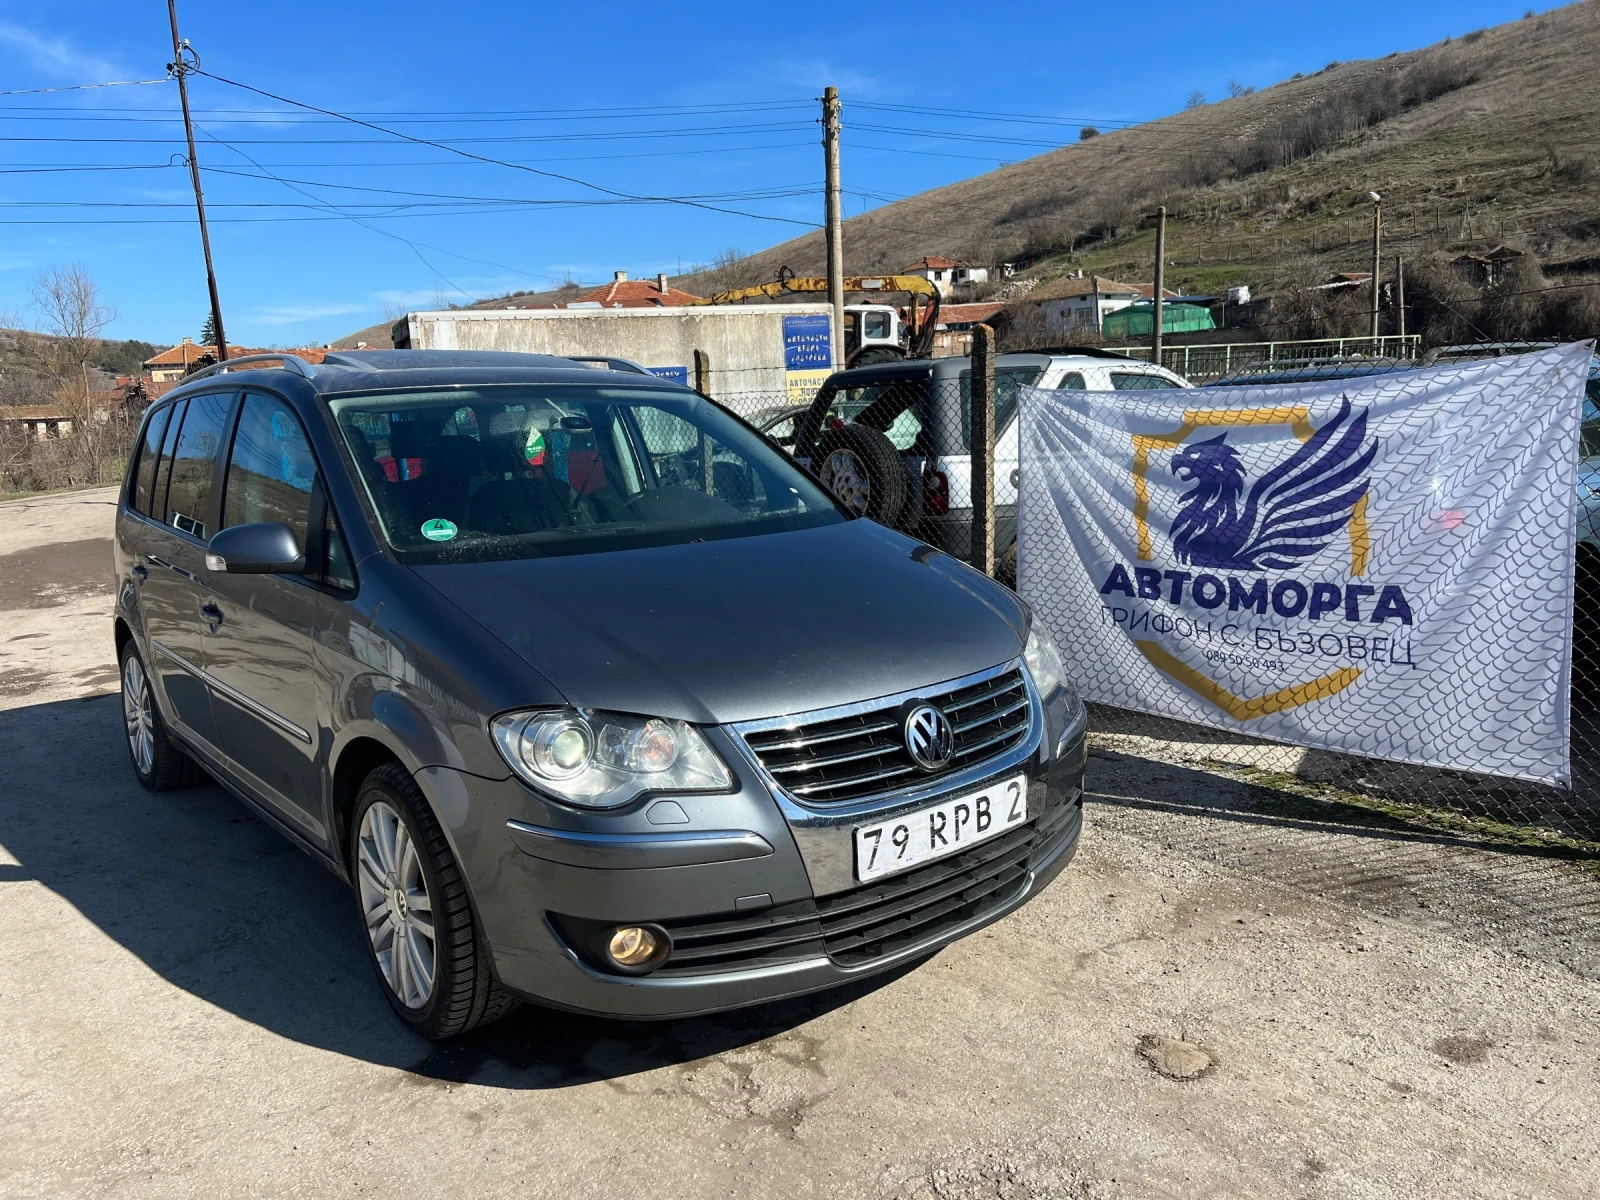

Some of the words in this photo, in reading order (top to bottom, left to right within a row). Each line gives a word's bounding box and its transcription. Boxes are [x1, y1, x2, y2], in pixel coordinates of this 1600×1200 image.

[789, 377, 828, 387] АВТОЧАСТ
[1099, 563, 1414, 626] АВТОМОРГА
[1100, 605, 1213, 643] ГРИФОН
[1221, 623, 1245, 648] С.
[1254, 627, 1417, 671] БЪЗОВЕЦ
[1206, 649, 1226, 663] 089
[1228, 653, 1243, 666] 50
[1245, 656, 1260, 669] 50
[1262, 659, 1285, 672] 493
[863, 824, 909, 870] 79
[929, 795, 992, 850] RPB
[1006, 781, 1022, 823] 2
